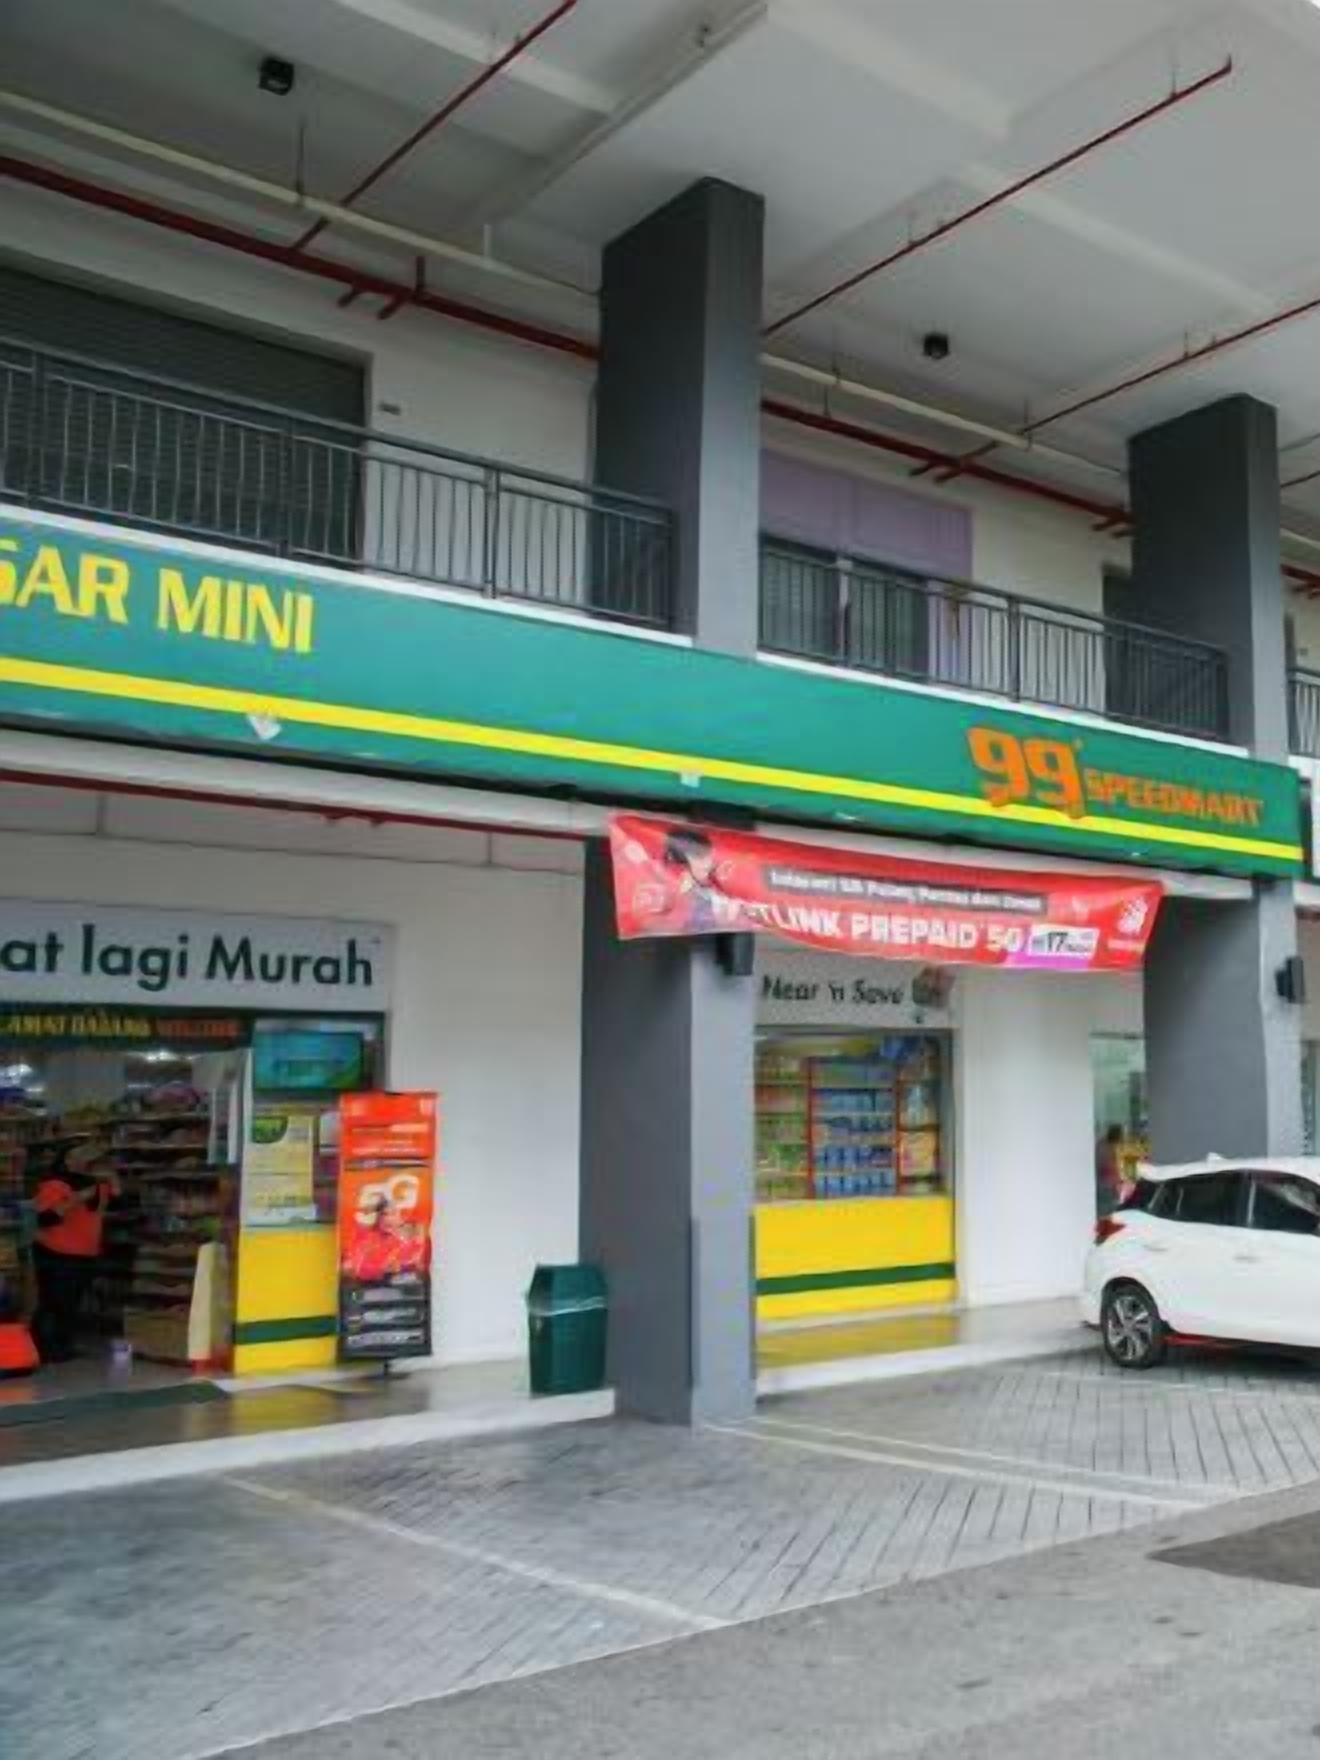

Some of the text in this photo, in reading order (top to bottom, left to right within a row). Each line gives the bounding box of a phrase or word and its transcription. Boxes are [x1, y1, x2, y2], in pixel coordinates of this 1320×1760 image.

[157, 567, 313, 654] MINI
[966, 726, 1264, 828] 99 SPEEDMART
[81, 923, 190, 992] lagi
[204, 935, 373, 986] Murah
[851, 911, 978, 949] PREPAID
